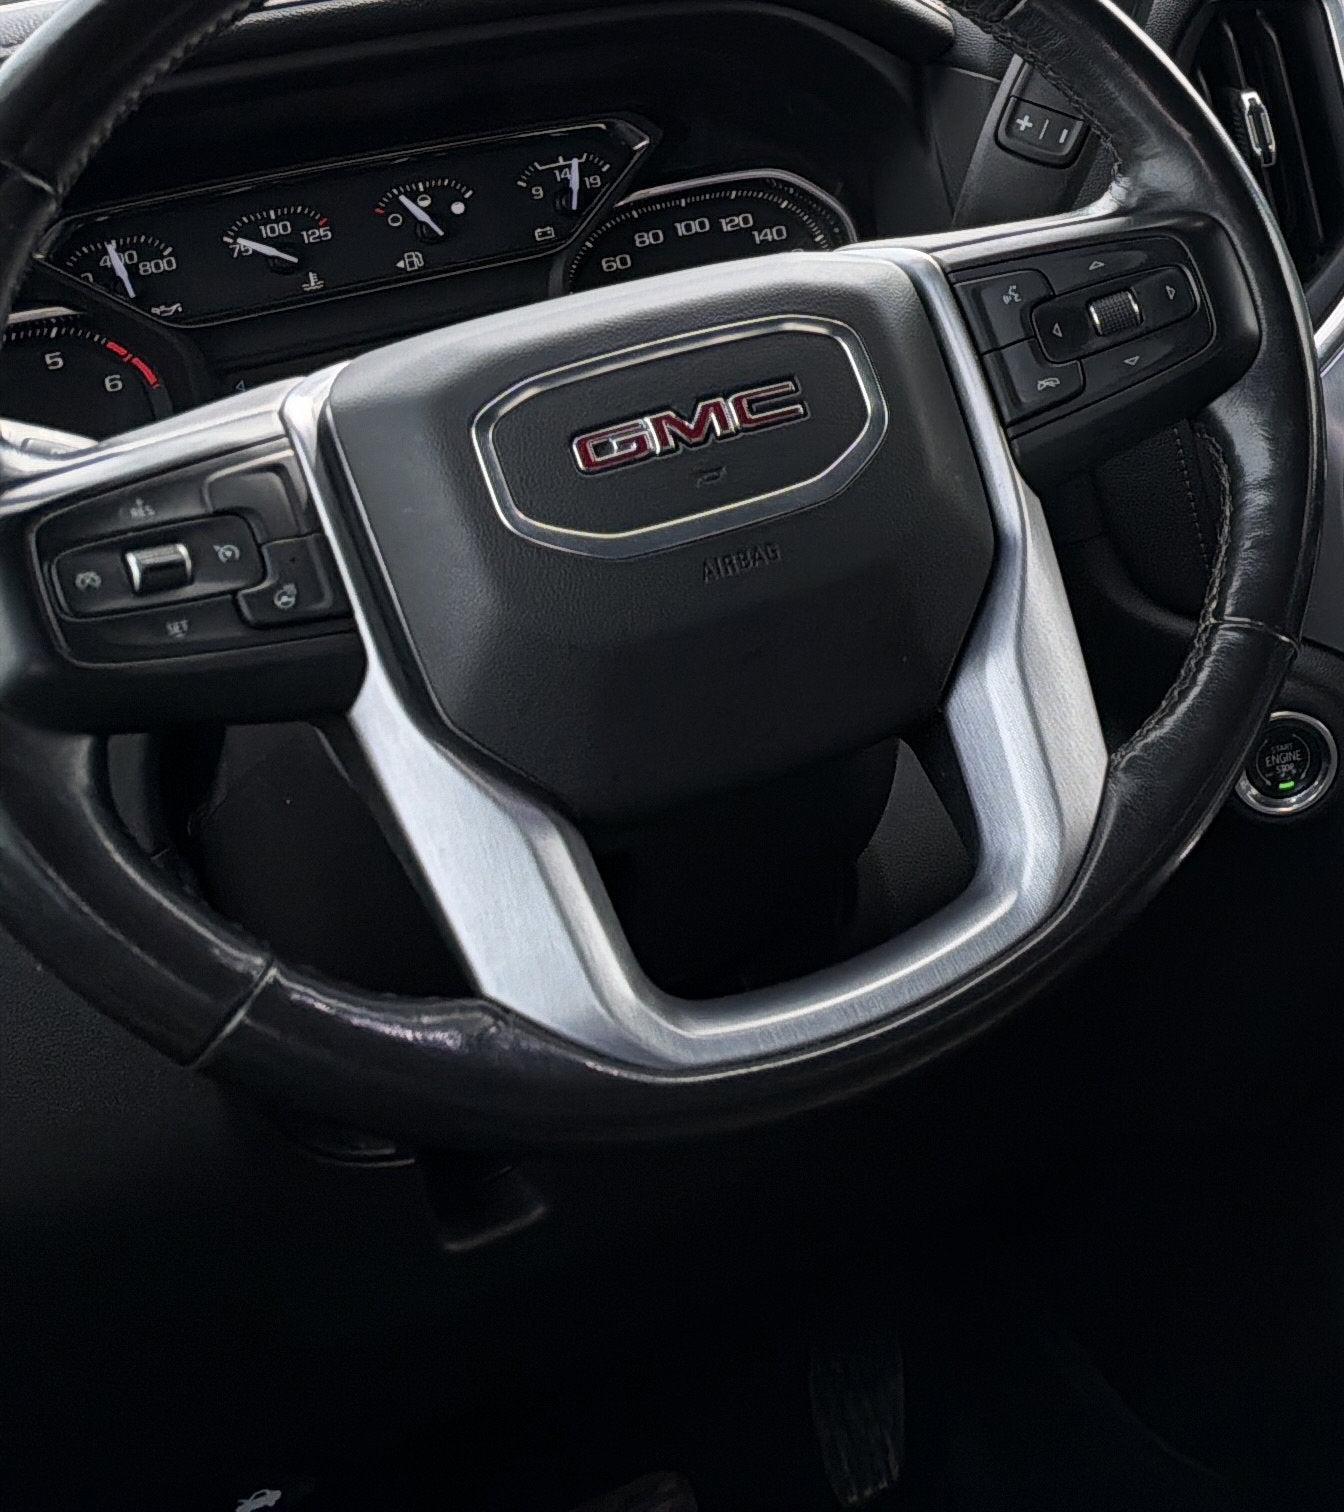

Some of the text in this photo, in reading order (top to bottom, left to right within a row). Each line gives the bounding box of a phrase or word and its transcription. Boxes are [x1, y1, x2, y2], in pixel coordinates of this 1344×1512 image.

[584, 175, 601, 188] 19
[531, 186, 544, 199] 9
[259, 221, 292, 238] 100
[674, 217, 710, 237] 100
[719, 213, 754, 232] 120
[301, 226, 332, 244] 125
[634, 228, 663, 248] 80
[752, 225, 787, 244] 140
[229, 244, 252, 258] 75
[138, 256, 176, 276] 800
[601, 253, 631, 272] 60
[45, 351, 64, 370] 5
[104, 374, 123, 392] 6
[574, 380, 806, 472] GMC
[702, 544, 782, 582] AIRBAG
[1265, 751, 1302, 768] ENGINE
